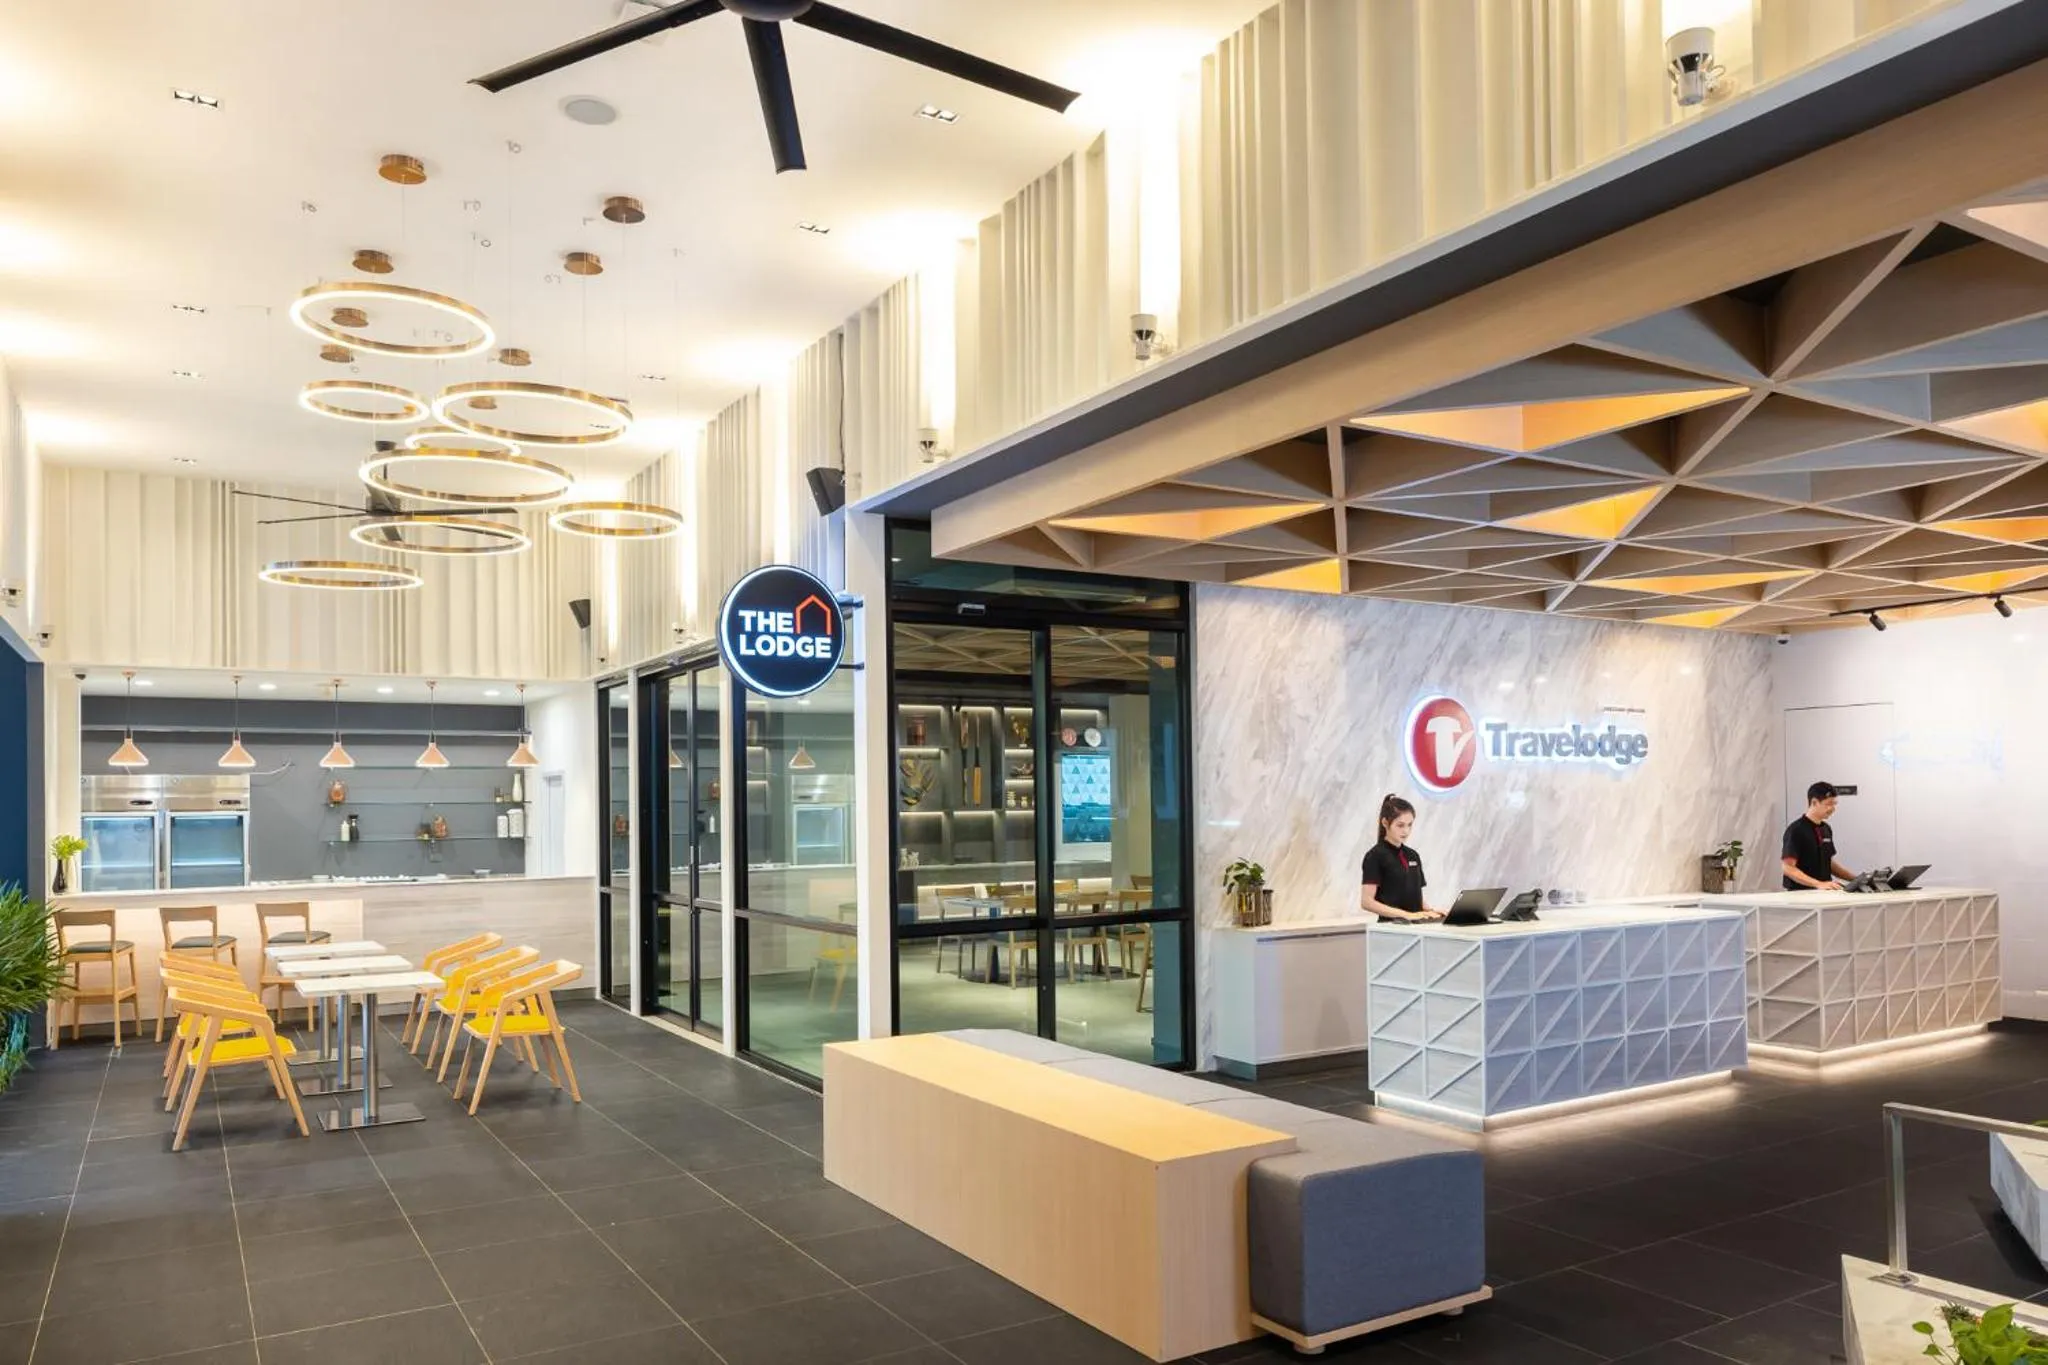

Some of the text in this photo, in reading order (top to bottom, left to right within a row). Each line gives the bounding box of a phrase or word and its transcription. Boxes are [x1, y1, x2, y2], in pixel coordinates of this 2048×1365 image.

[738, 609, 794, 633] THE
[739, 634, 832, 658] LODGE
[1485, 723, 1648, 765] Travelodge
